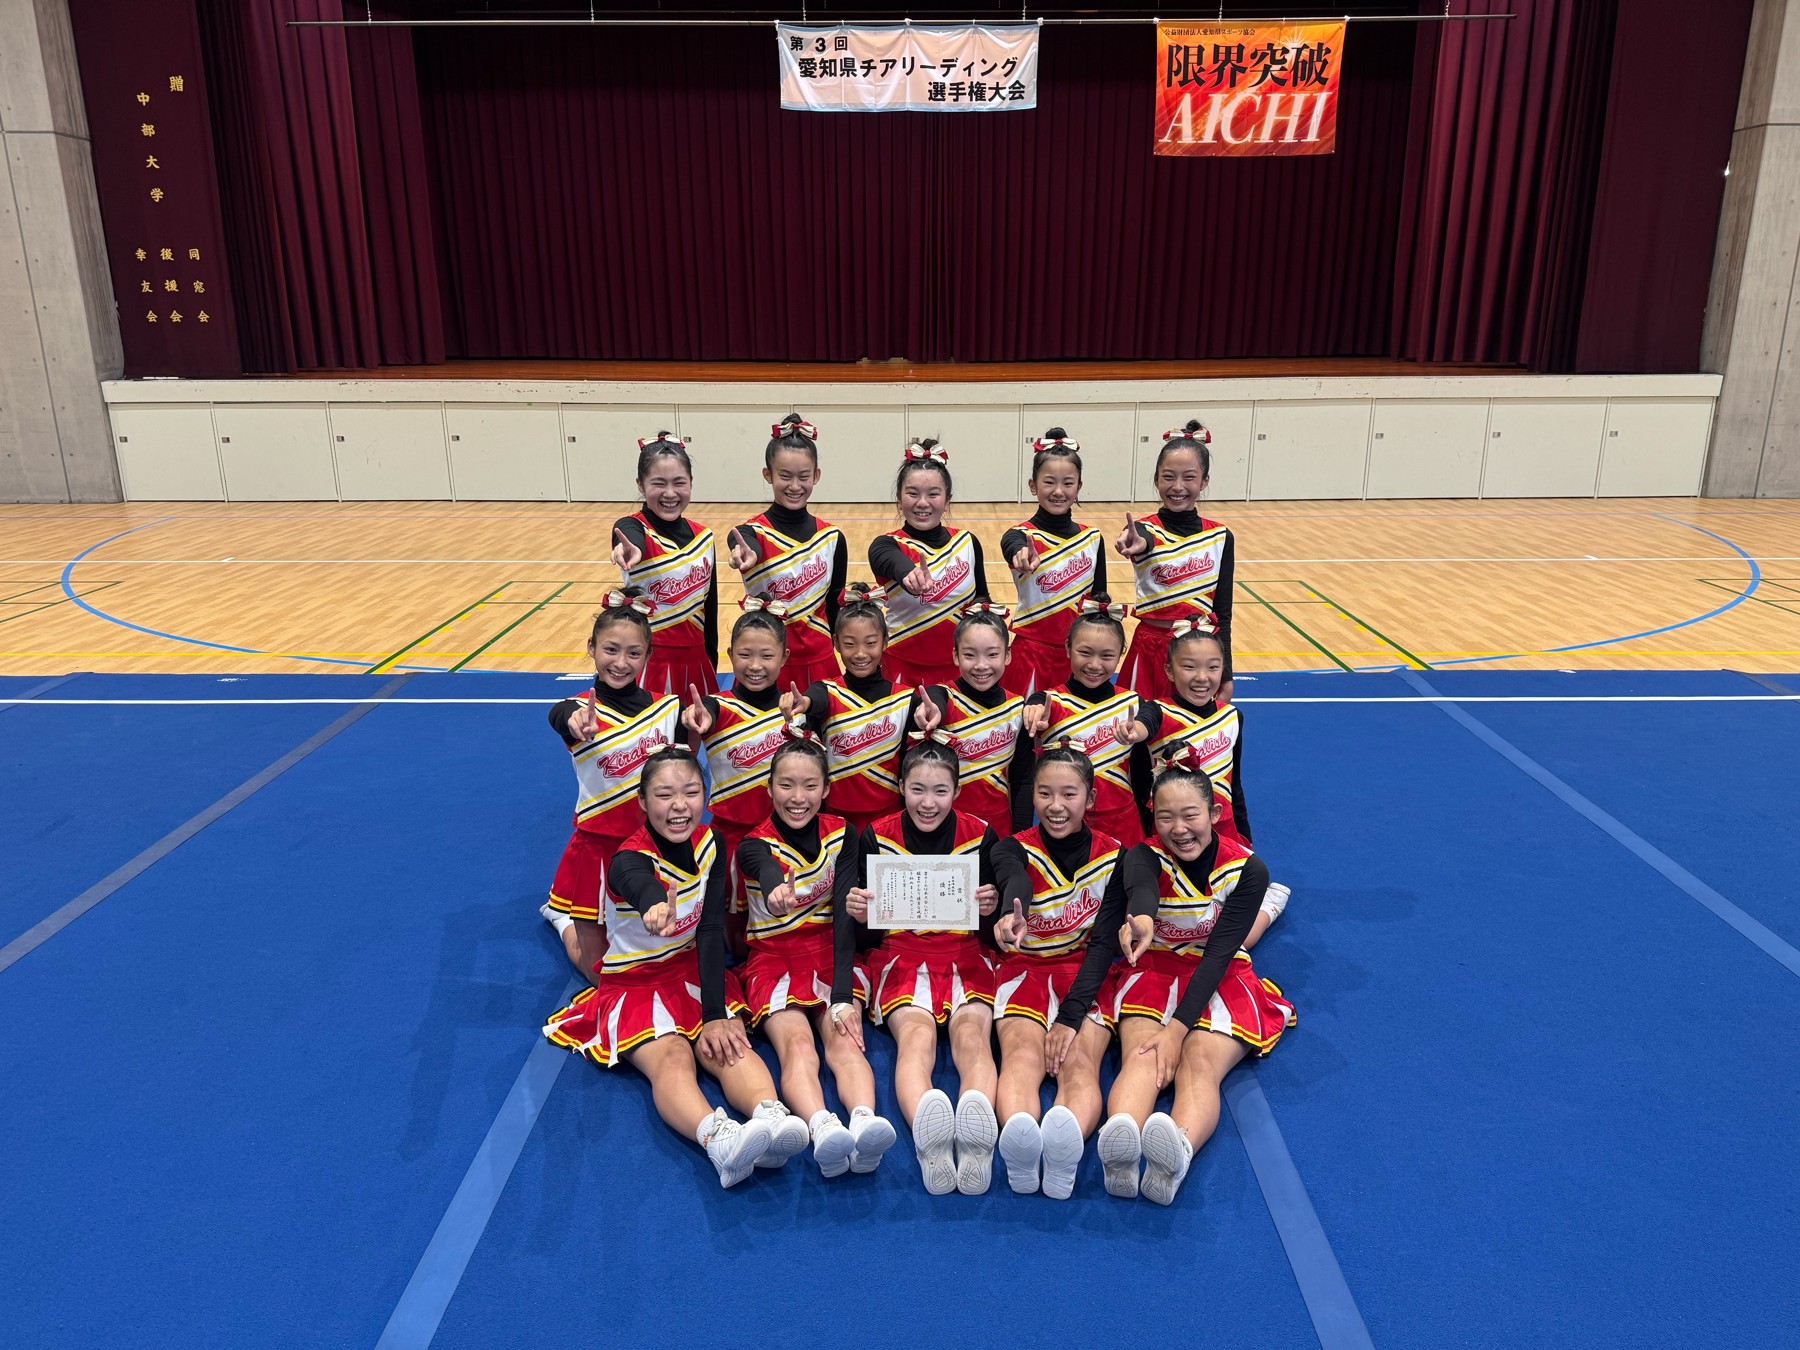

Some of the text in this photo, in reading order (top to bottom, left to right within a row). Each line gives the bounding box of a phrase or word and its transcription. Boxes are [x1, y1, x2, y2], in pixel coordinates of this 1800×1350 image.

[789, 34, 848, 54] 第3回
[1164, 28, 1256, 36] 公益財団法人愛知県スポーツ協会
[169, 75, 184, 92] 贈
[798, 56, 1019, 79] 愛知県チアリーディング
[1165, 42, 1331, 89] 限界突破
[927, 80, 1026, 102] 選手権大会
[1159, 90, 1333, 144] AICHI
[136, 92, 164, 202] 中部大学
[135, 247, 158, 323] 幸友会
[160, 247, 184, 323] 後援会
[188, 248, 210, 323] 同窓会
[648, 556, 712, 605] Kiralish
[767, 553, 828, 602] Kiralish
[1036, 550, 1093, 594] Kiralish
[1151, 551, 1215, 587] Kiralish
[727, 732, 786, 769] Kiralis
[828, 715, 897, 757] Kiralish
